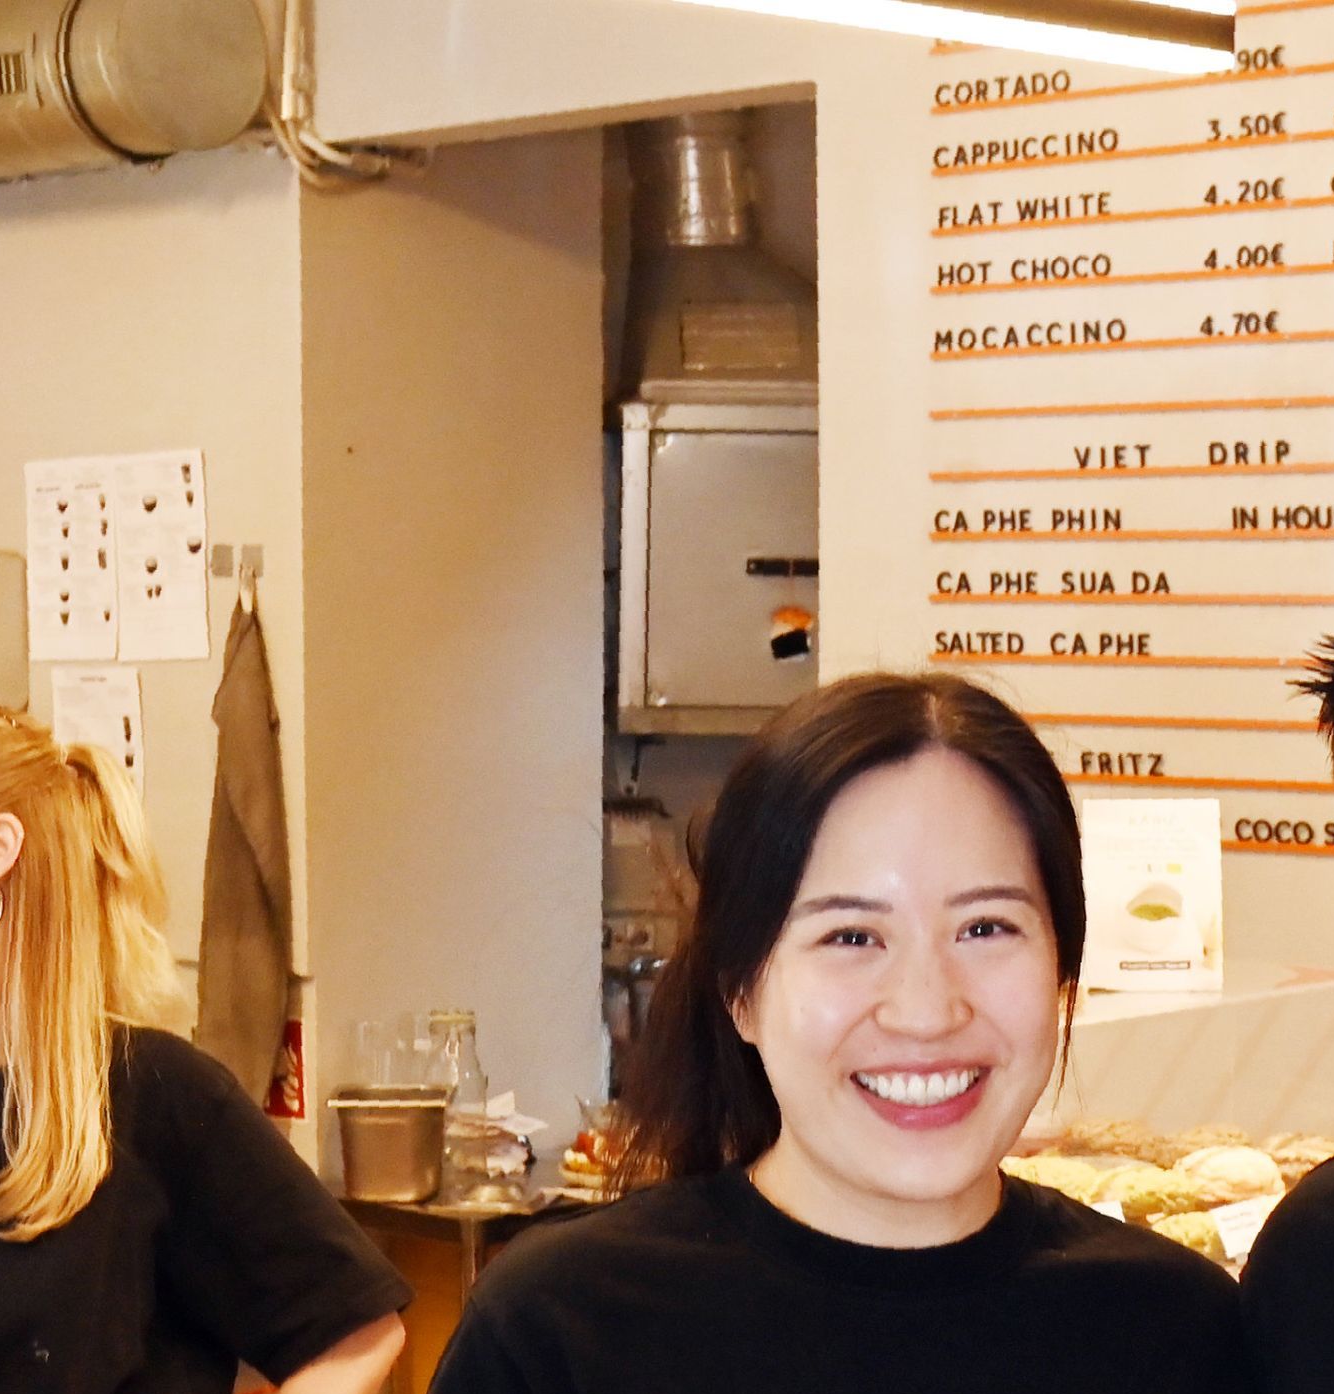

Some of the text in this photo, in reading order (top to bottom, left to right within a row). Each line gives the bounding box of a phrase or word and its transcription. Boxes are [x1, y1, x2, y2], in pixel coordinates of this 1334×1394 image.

[935, 71, 1070, 105] CORTADO
[1208, 111, 1285, 141] 3.50€
[933, 128, 1118, 168] CAPPUCCINO
[1203, 177, 1284, 205] 4.20€
[938, 192, 1110, 228] FLAT WHITE
[937, 253, 1111, 286] HOT CHOCO
[1203, 243, 1284, 270] 4.00€
[934, 318, 1127, 353] MOCACCINO
[1200, 310, 1278, 337] 4.70€
[1074, 444, 1151, 469] VIET
[1208, 439, 1290, 466] DRIP
[934, 508, 1122, 533] CA PHE PHIN
[1232, 506, 1260, 530] IN
[936, 570, 1171, 595] CA PHE SUA DA
[935, 631, 1151, 656] SALTED CA PHE
[1080, 750, 1164, 777] FRITZ
[1234, 818, 1315, 845] COCO
